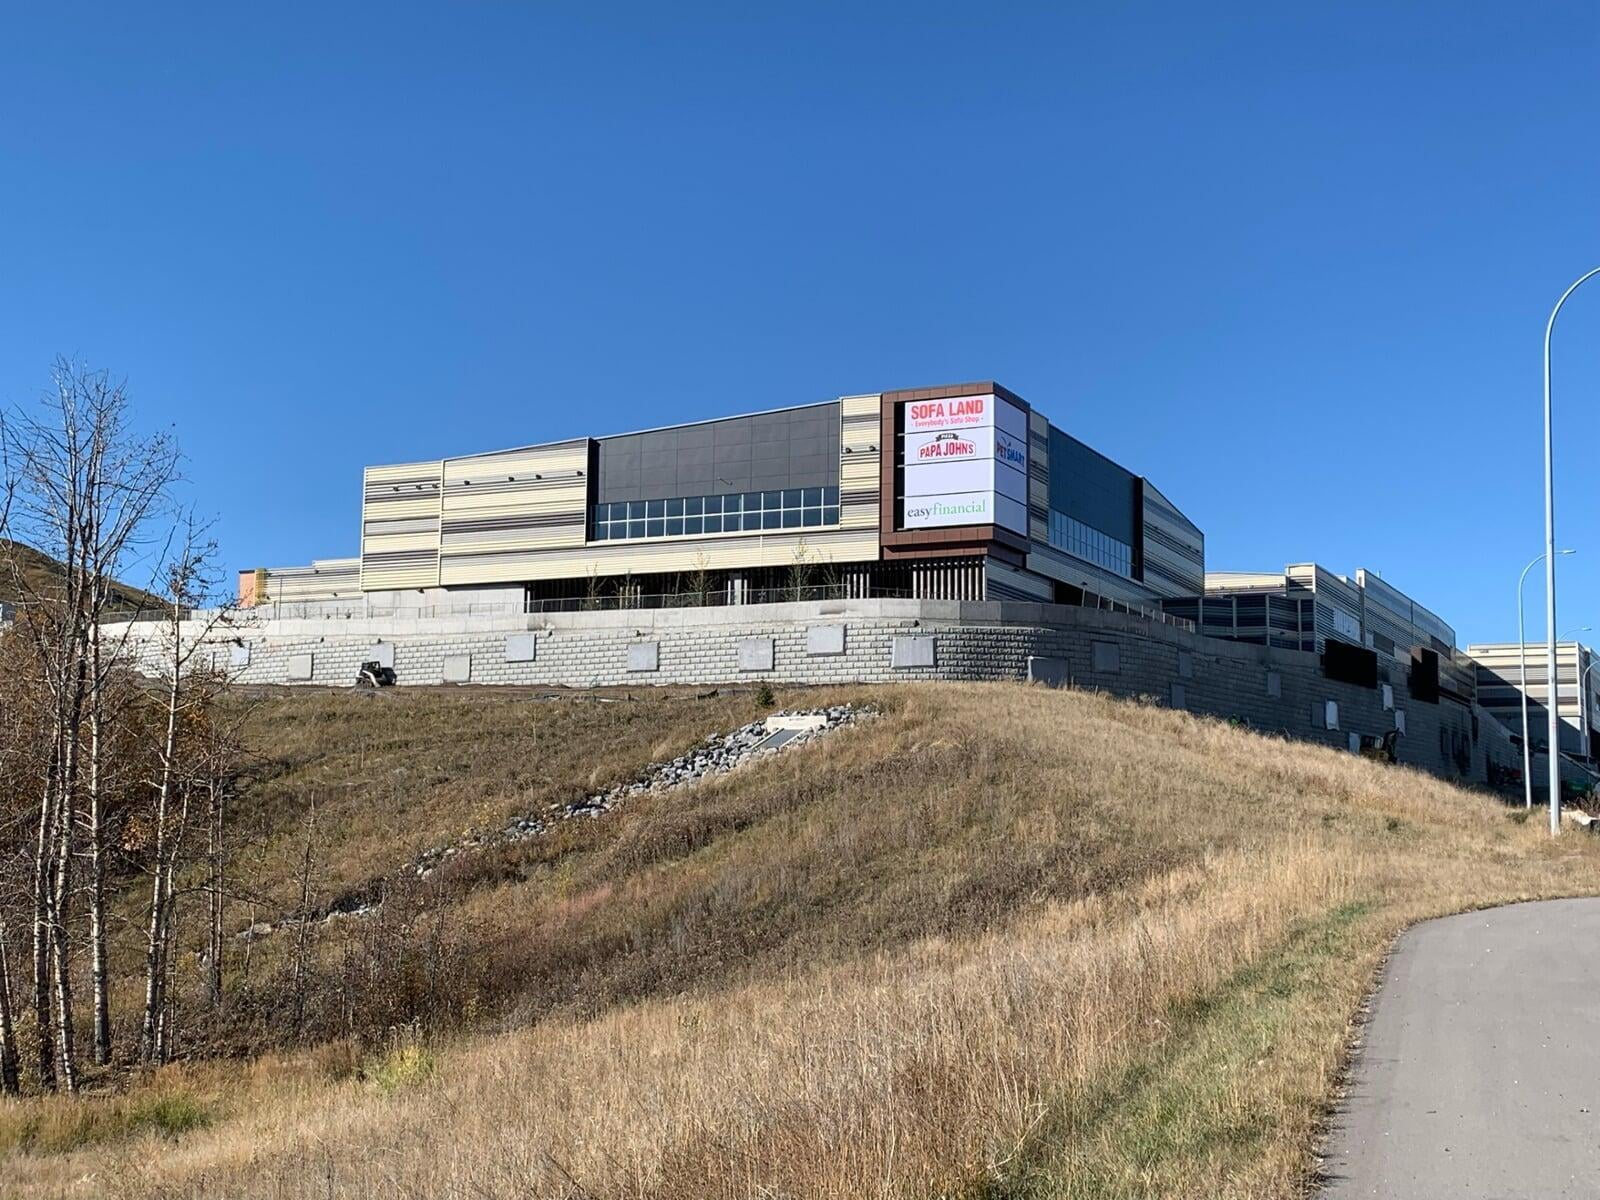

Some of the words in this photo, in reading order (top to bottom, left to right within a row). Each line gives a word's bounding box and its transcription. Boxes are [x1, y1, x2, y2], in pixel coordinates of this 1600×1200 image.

[911, 403, 944, 419] SOFA
[949, 400, 984, 416] LAND
[951, 417, 964, 425] Sofa
[965, 416, 980, 424] Shop
[920, 444, 942, 458] PAPA
